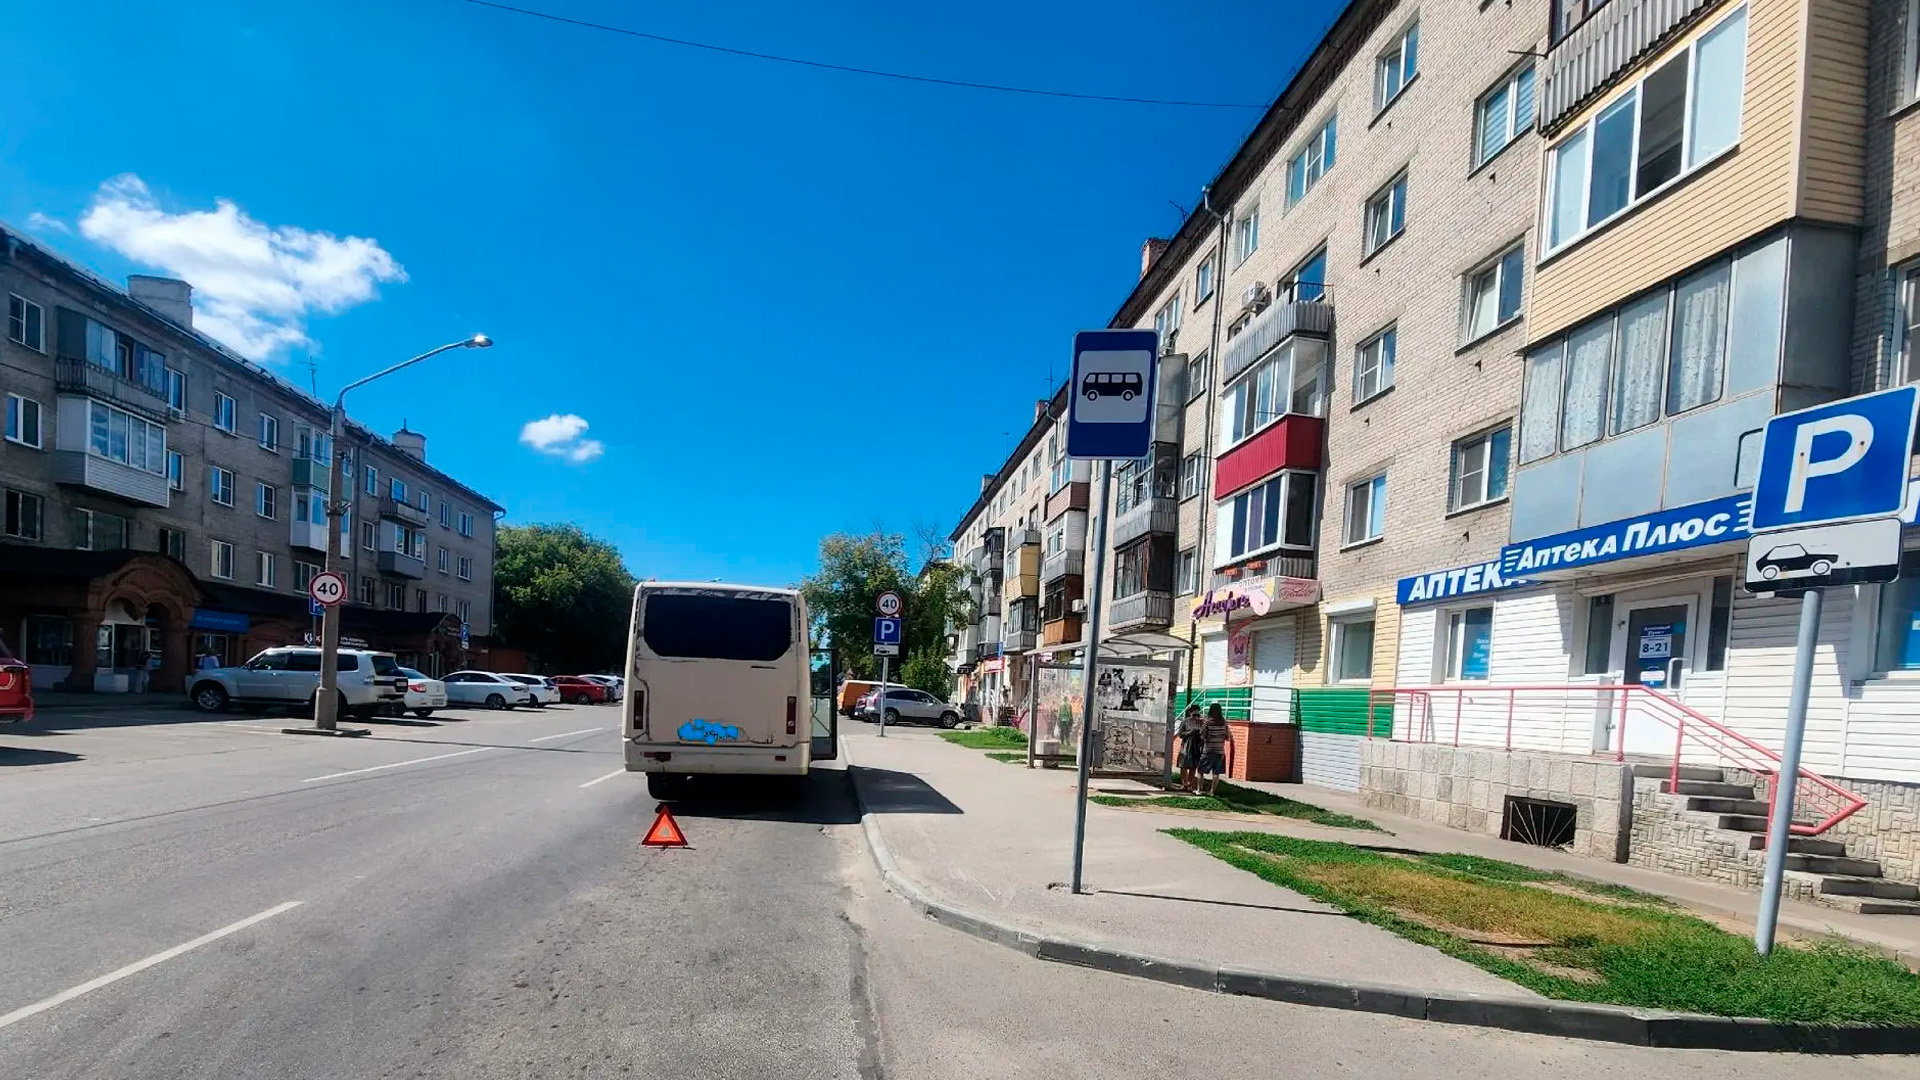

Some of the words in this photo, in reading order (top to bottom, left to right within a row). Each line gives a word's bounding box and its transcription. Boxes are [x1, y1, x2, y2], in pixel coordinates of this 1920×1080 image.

[1784, 414, 1874, 513] P
[317, 582, 339, 596] 40
[882, 598, 897, 609] 40
[881, 621, 895, 639] P
[1643, 643, 1668, 653] 8-21
